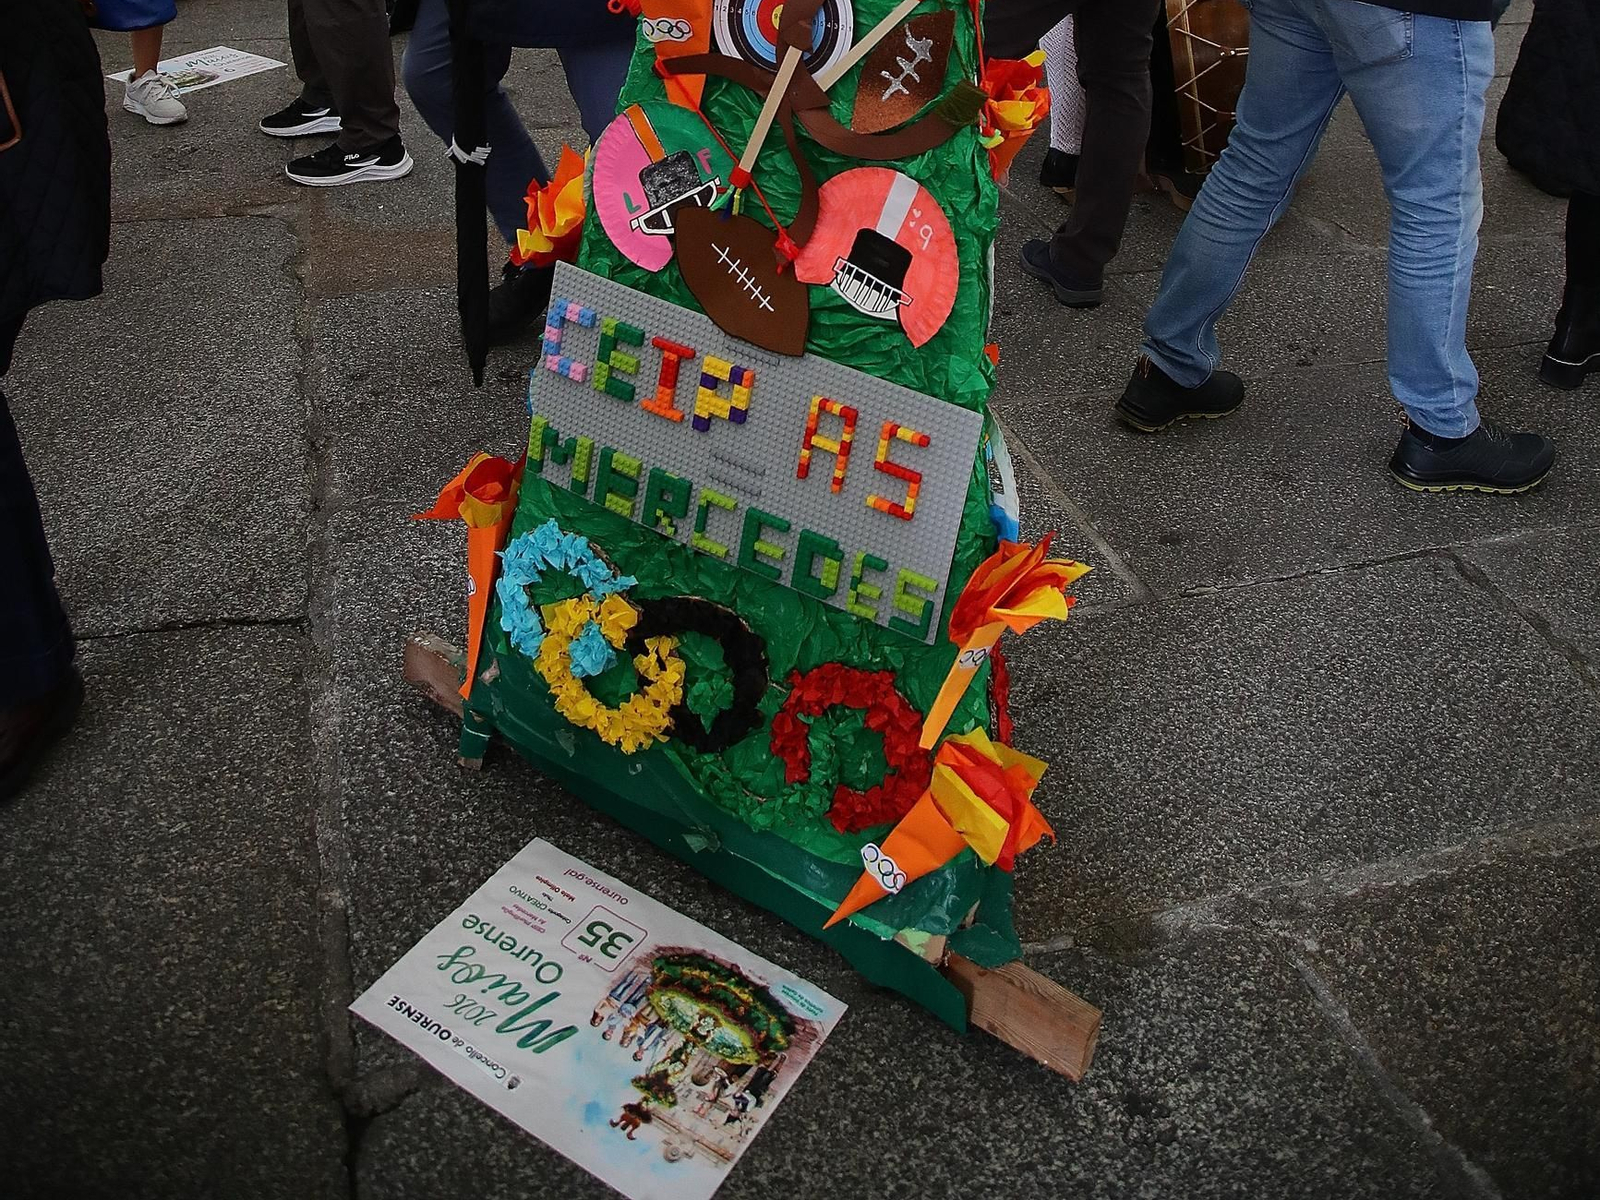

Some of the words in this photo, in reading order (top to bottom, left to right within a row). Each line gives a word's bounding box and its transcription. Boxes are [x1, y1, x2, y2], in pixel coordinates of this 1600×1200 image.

[696, 147, 712, 175] F
[623, 191, 642, 214] L
[920, 224, 934, 251] 9
[544, 298, 756, 432] CEIP
[797, 394, 931, 521] AS
[525, 414, 938, 641] MERCEDES
[509, 885, 548, 911] CREATIVO
[563, 869, 629, 905] ourense.gal
[462, 914, 563, 984] Ourense
[577, 920, 634, 959] 35
[437, 946, 579, 1054] Maios
[443, 993, 498, 1026] 2026
[387, 995, 452, 1041] OURENSE
[451, 1036, 465, 1048] de
[465, 1044, 507, 1079] Concello
